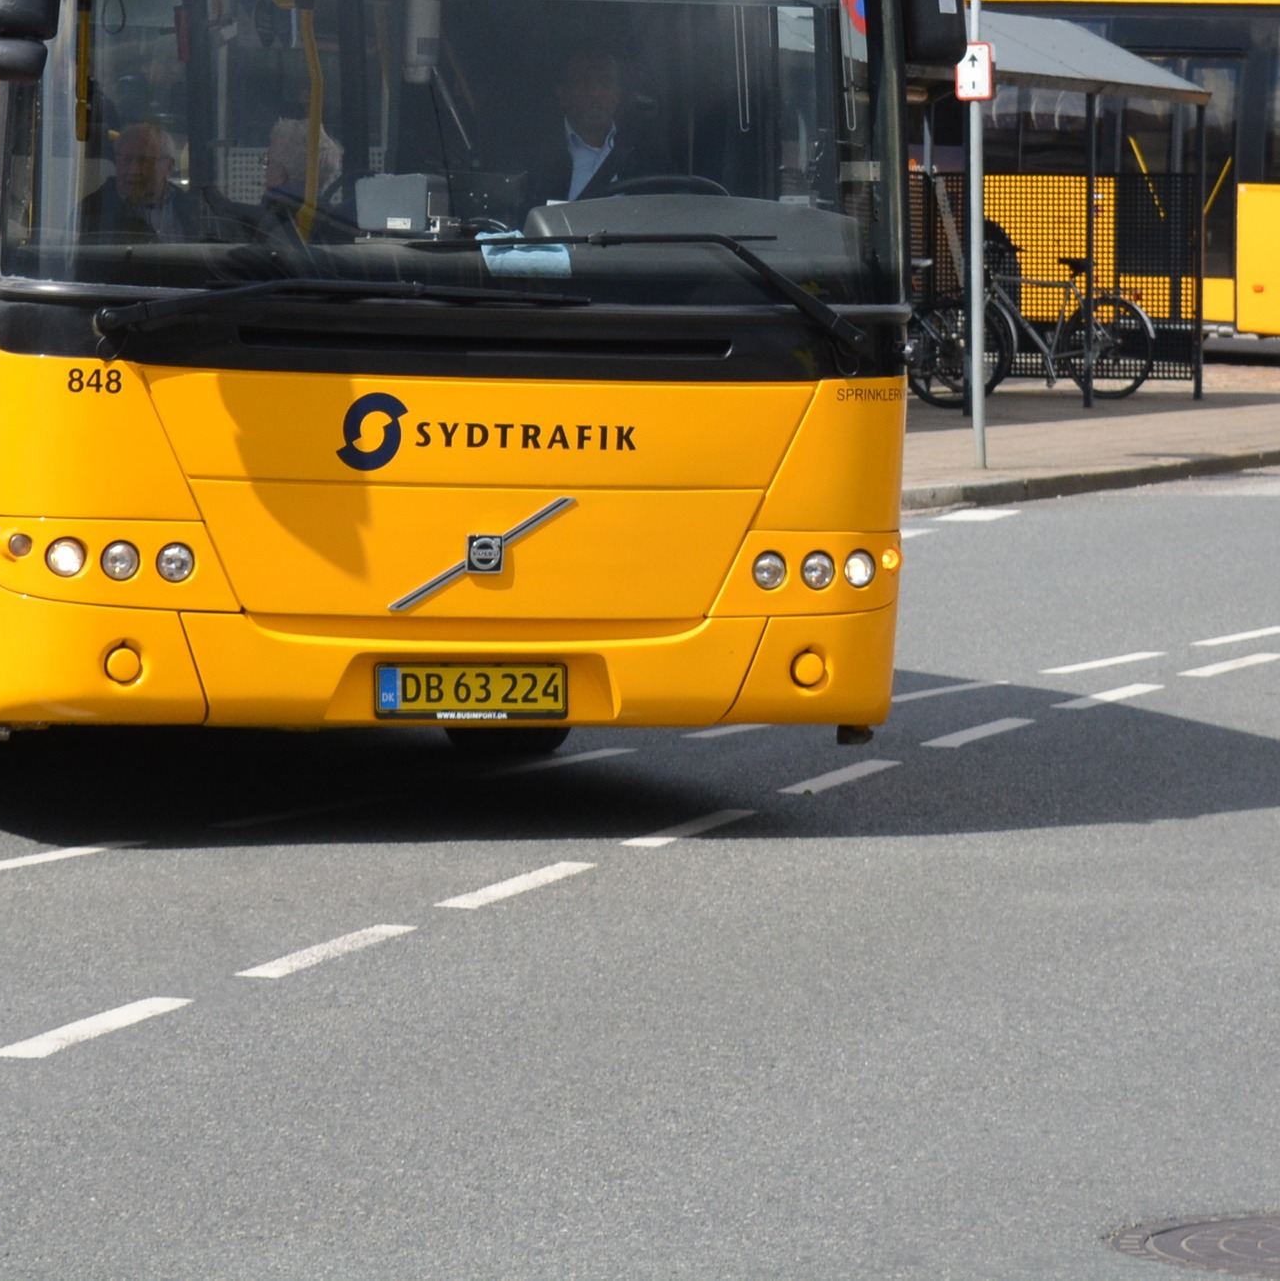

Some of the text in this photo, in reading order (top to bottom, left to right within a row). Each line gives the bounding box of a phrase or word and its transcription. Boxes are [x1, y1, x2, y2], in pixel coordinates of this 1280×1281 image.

[67, 368, 122, 394] 848
[415, 421, 637, 451] SYDTRAFIK
[381, 672, 559, 703] DK DB 63 224
